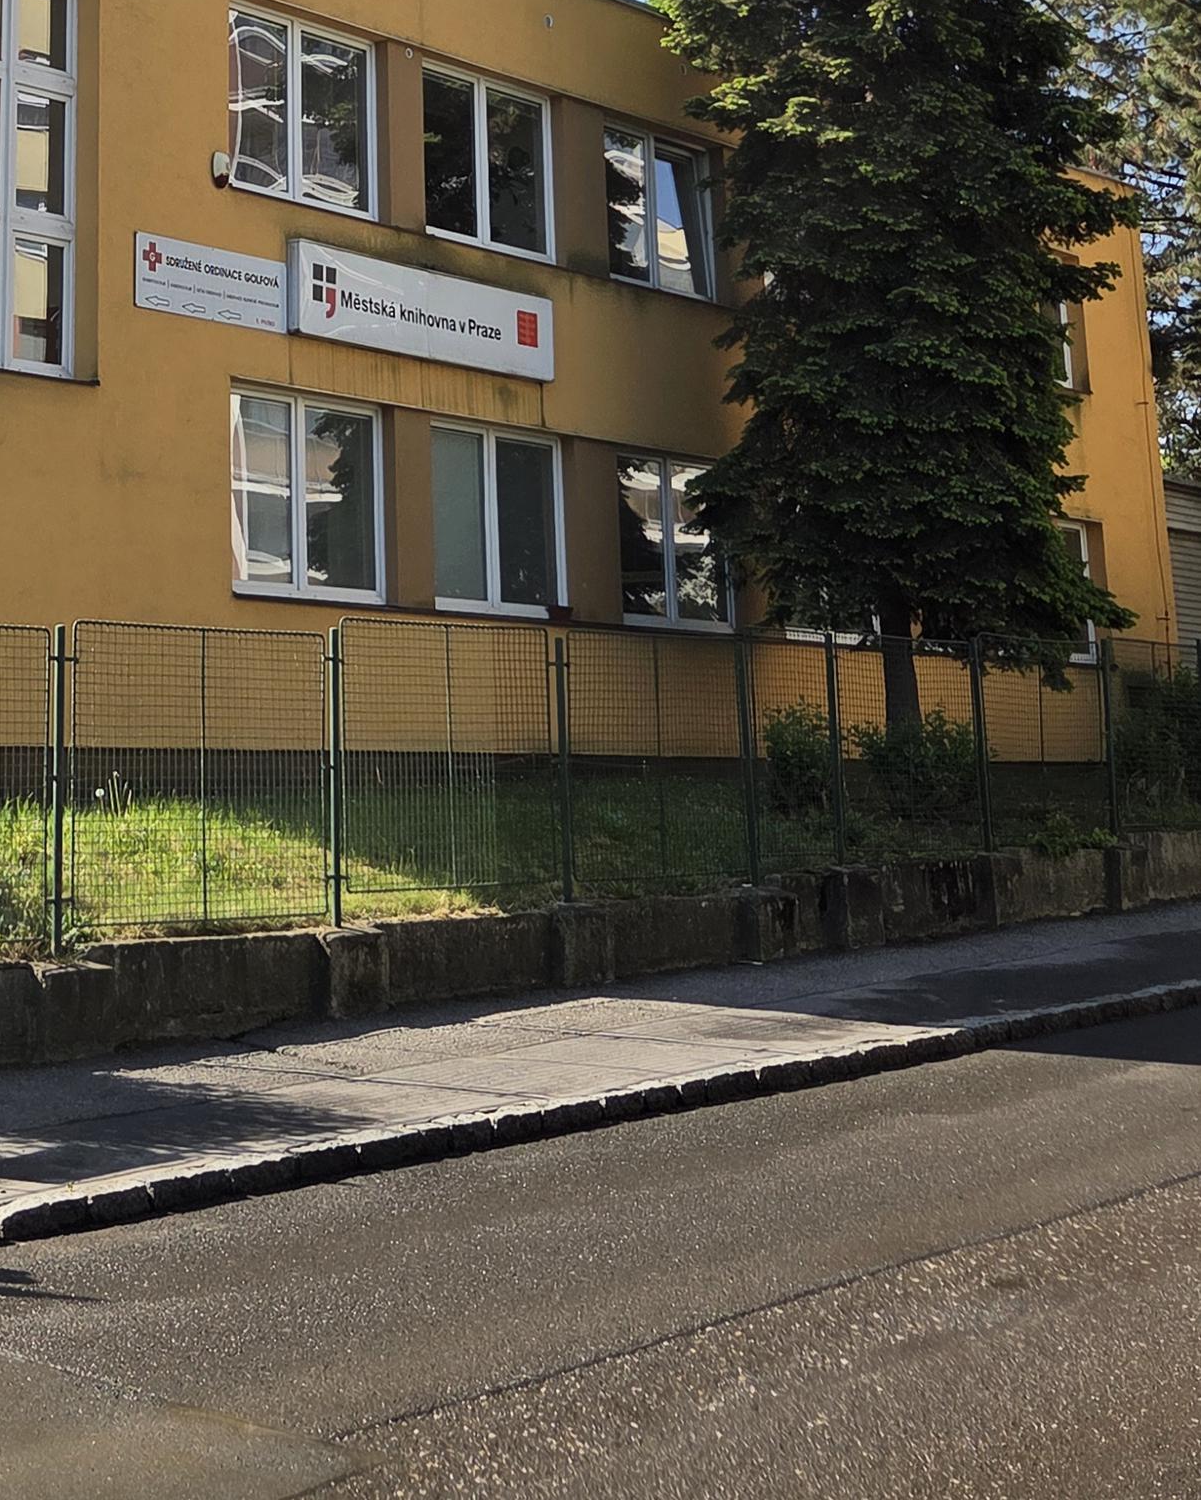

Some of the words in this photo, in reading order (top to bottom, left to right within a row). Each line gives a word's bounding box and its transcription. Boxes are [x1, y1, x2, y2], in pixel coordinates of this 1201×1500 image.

[165, 255, 202, 273] SDRUŽENÉ
[203, 263, 242, 282] ORDINACE
[244, 273, 280, 288] GOLFOVÁ
[340, 290, 396, 319] Městská
[399, 303, 456, 332] knihovna
[459, 320, 467, 333] v
[468, 319, 502, 341] Praze
